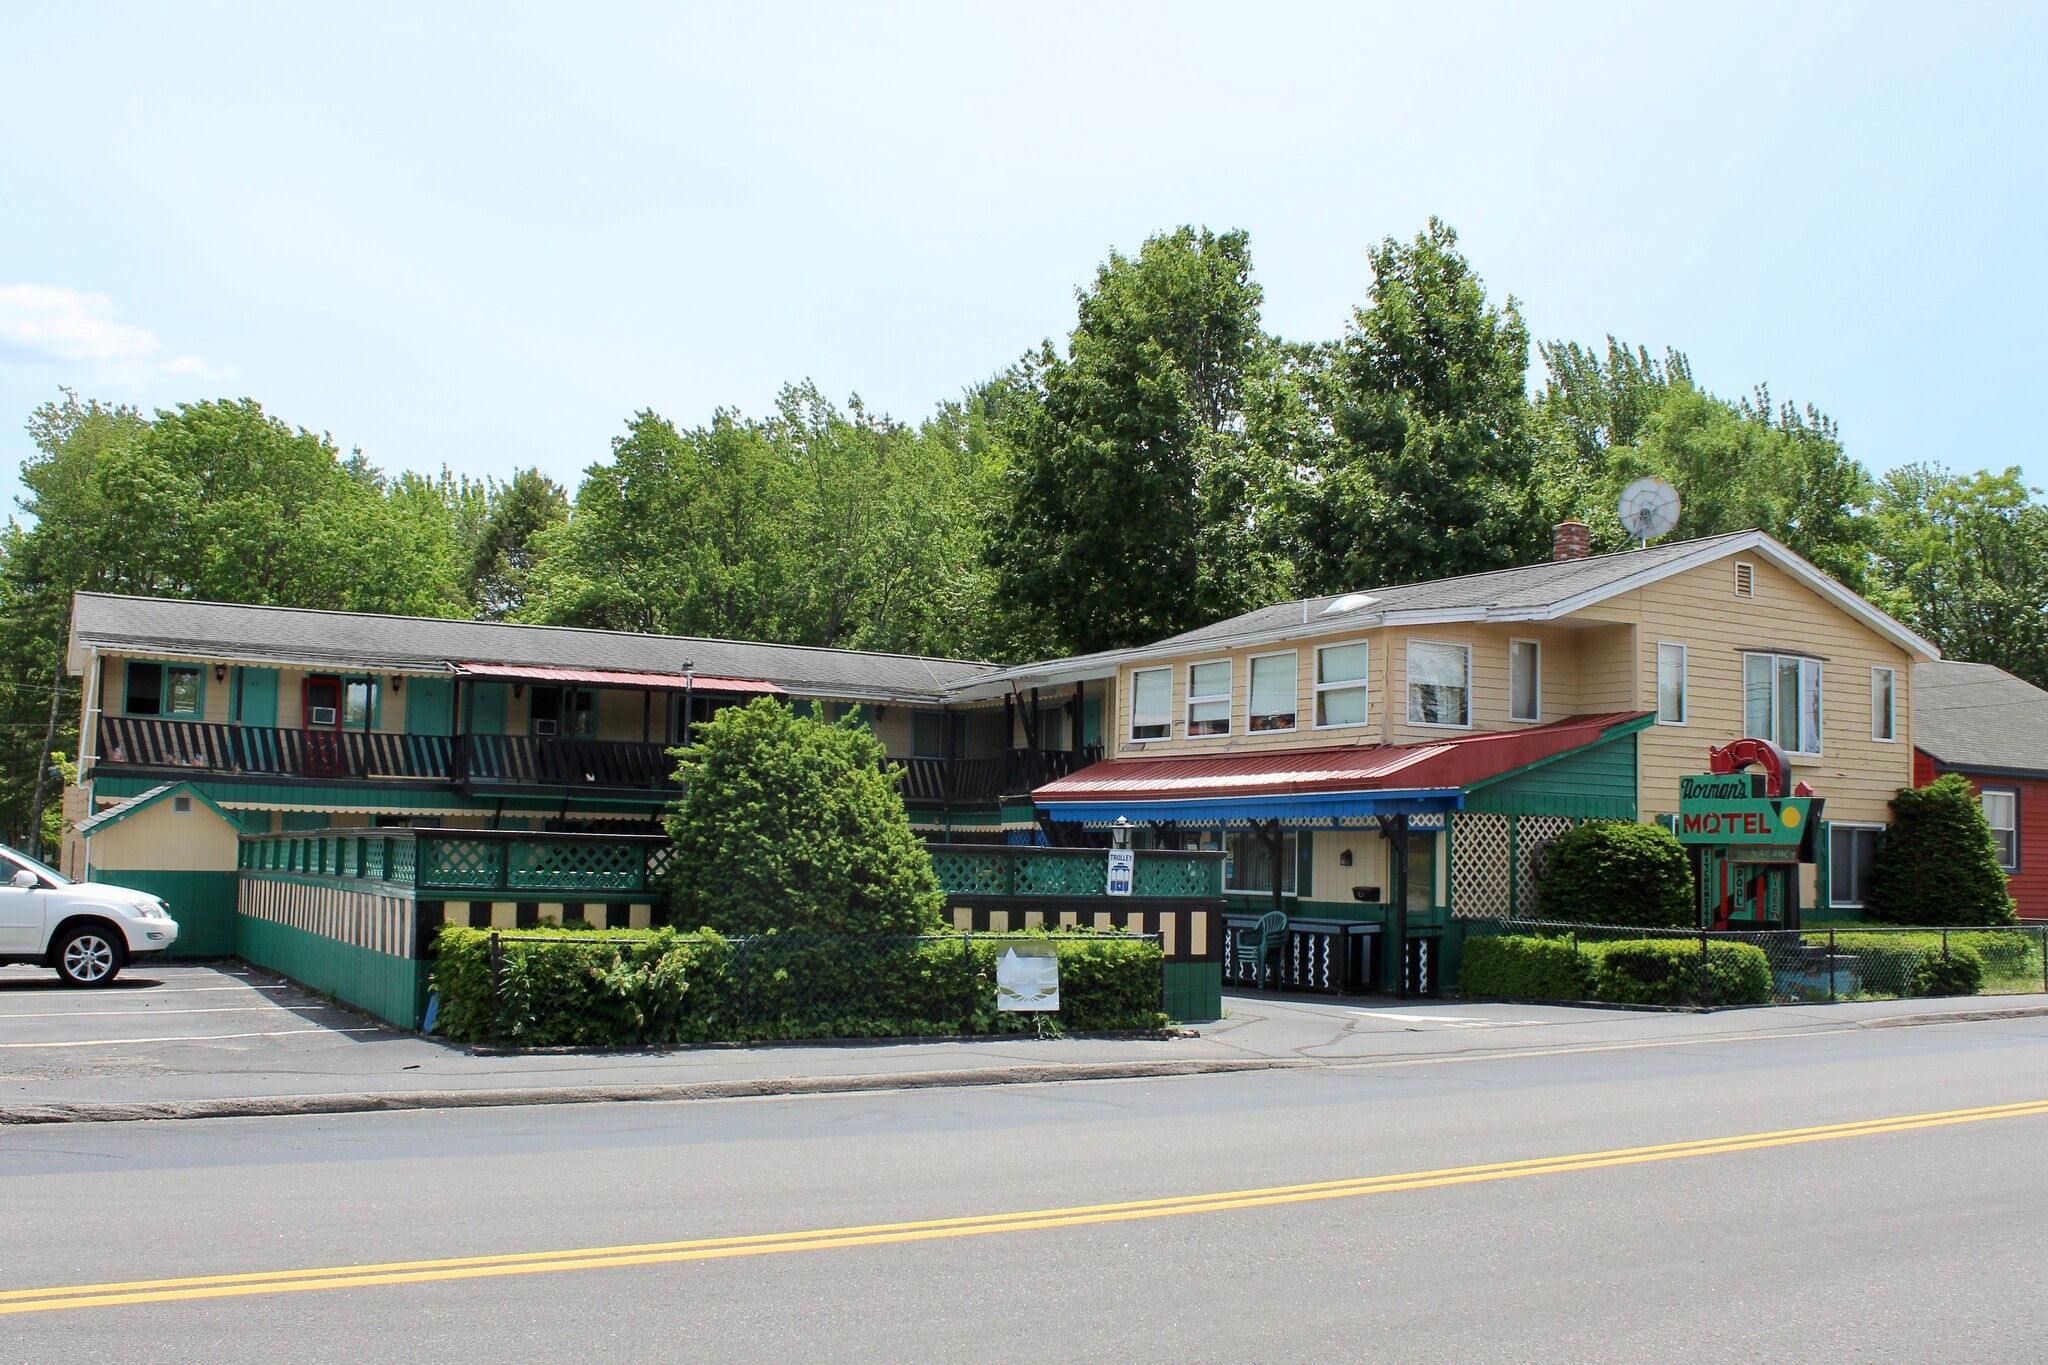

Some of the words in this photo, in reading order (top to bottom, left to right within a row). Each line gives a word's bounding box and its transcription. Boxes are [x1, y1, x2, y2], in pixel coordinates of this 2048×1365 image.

[1681, 777, 1748, 800] Norman's
[1684, 813, 1771, 834] MOTEL
[1752, 849, 1796, 859] VACANCY
